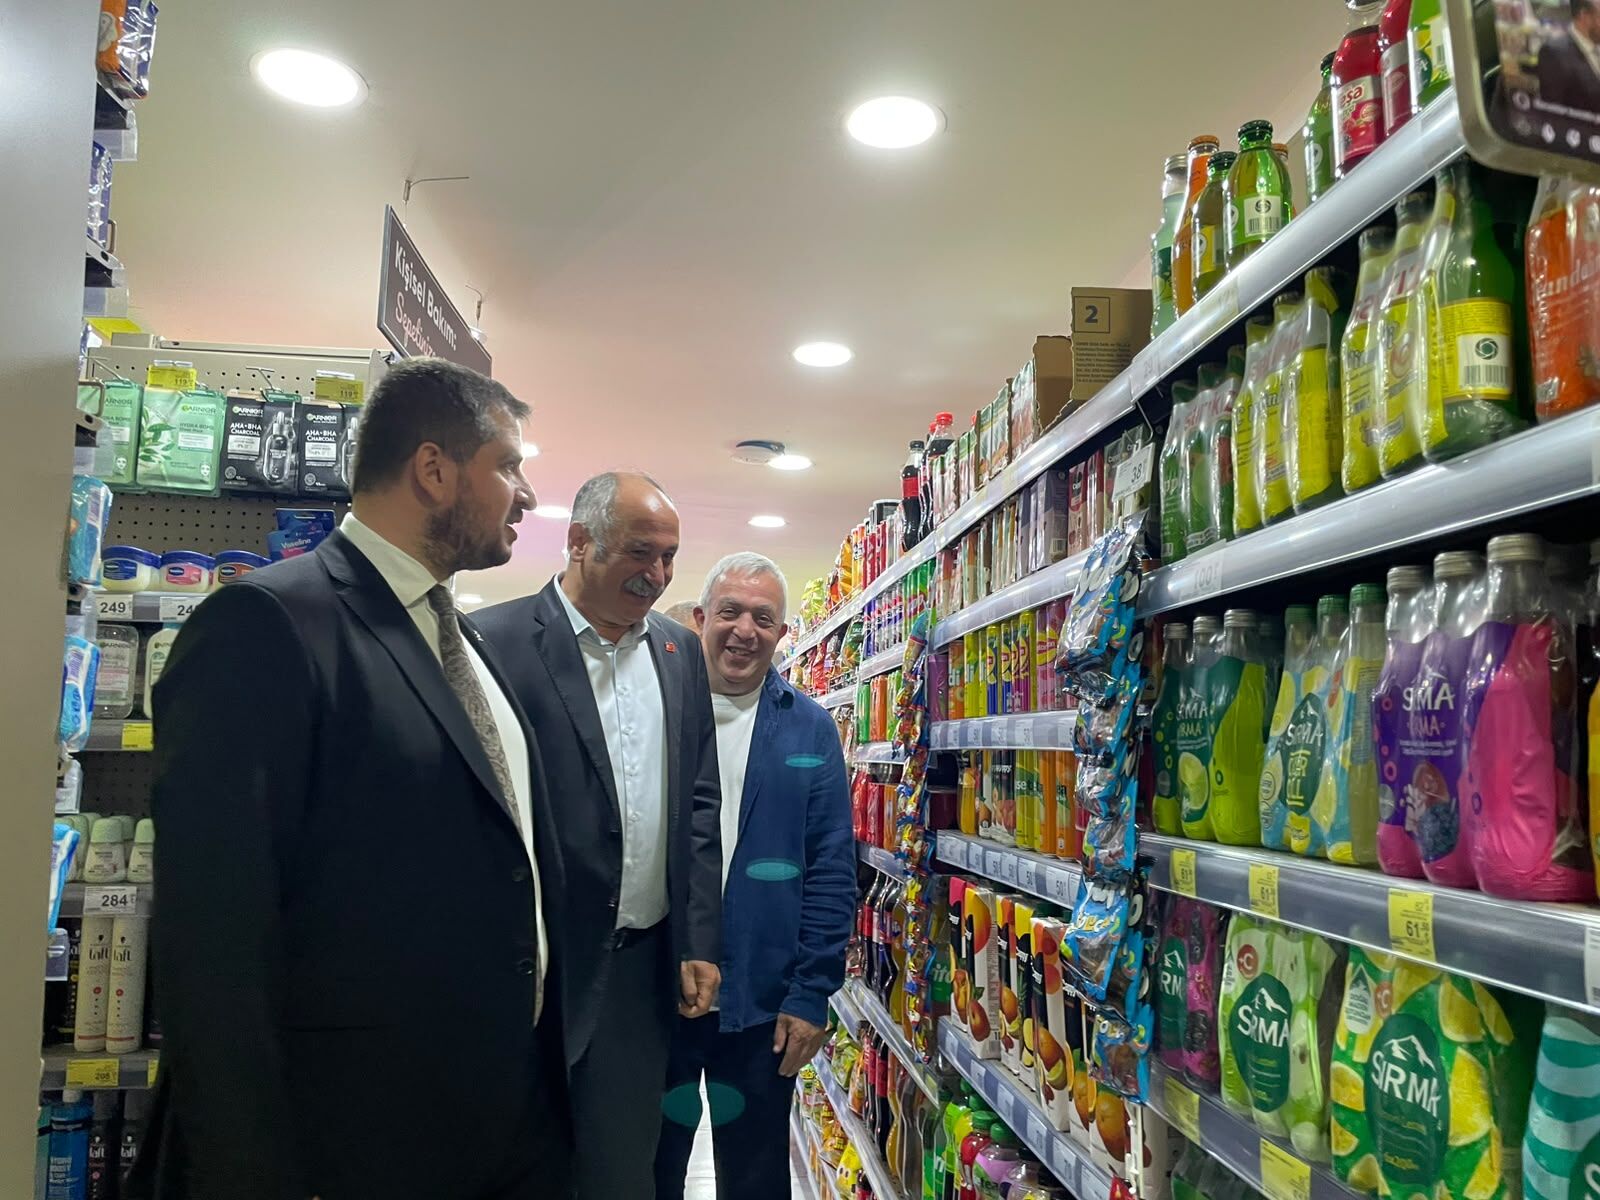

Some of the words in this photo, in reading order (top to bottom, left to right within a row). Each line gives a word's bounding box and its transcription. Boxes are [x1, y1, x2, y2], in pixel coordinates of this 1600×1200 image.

[394, 240, 426, 308] Kişisel
[1085, 305, 1098, 323] 2
[395, 291, 437, 359] Sepetiniz
[232, 406, 264, 415] GARNIER
[306, 413, 338, 421] GARNIER
[231, 428, 260, 436] CHARCOAL
[100, 602, 126, 613] 249
[177, 605, 198, 616] 24
[101, 894, 129, 907] 284
